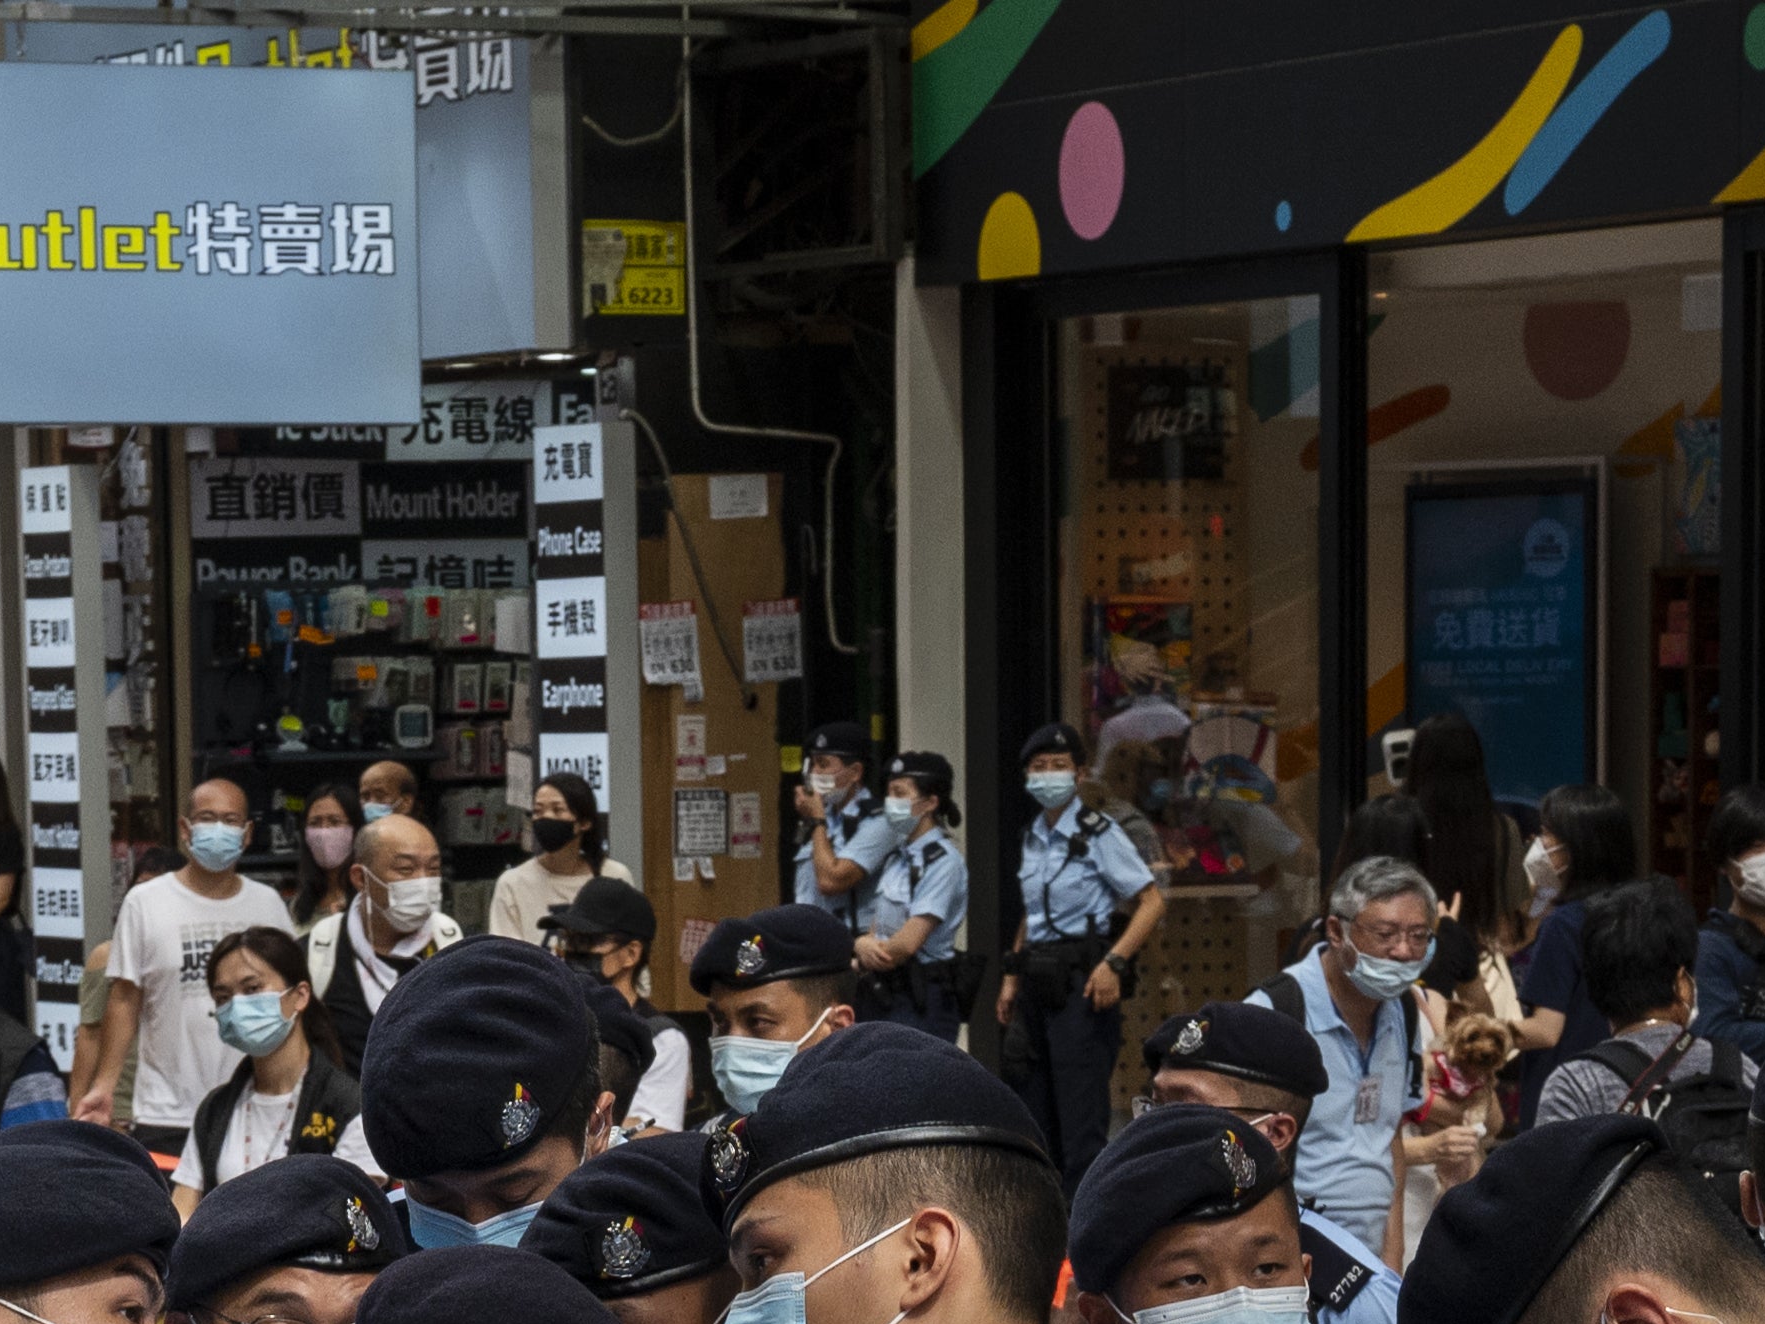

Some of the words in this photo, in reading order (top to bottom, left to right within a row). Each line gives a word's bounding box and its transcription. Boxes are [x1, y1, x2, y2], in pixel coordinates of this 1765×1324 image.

[402, 396, 535, 444] 充電線
[544, 442, 593, 481] 充電寶
[206, 472, 346, 522] 直銷價
[366, 483, 441, 520] Mount
[446, 481, 520, 520] Holder
[538, 528, 574, 557] Phone
[575, 526, 601, 555] Case
[547, 599, 596, 637] 手機殼
[1433, 608, 1561, 650] 免費送貨
[541, 677, 603, 714] Earphone
[1329, 1264, 1365, 1303] 27782
